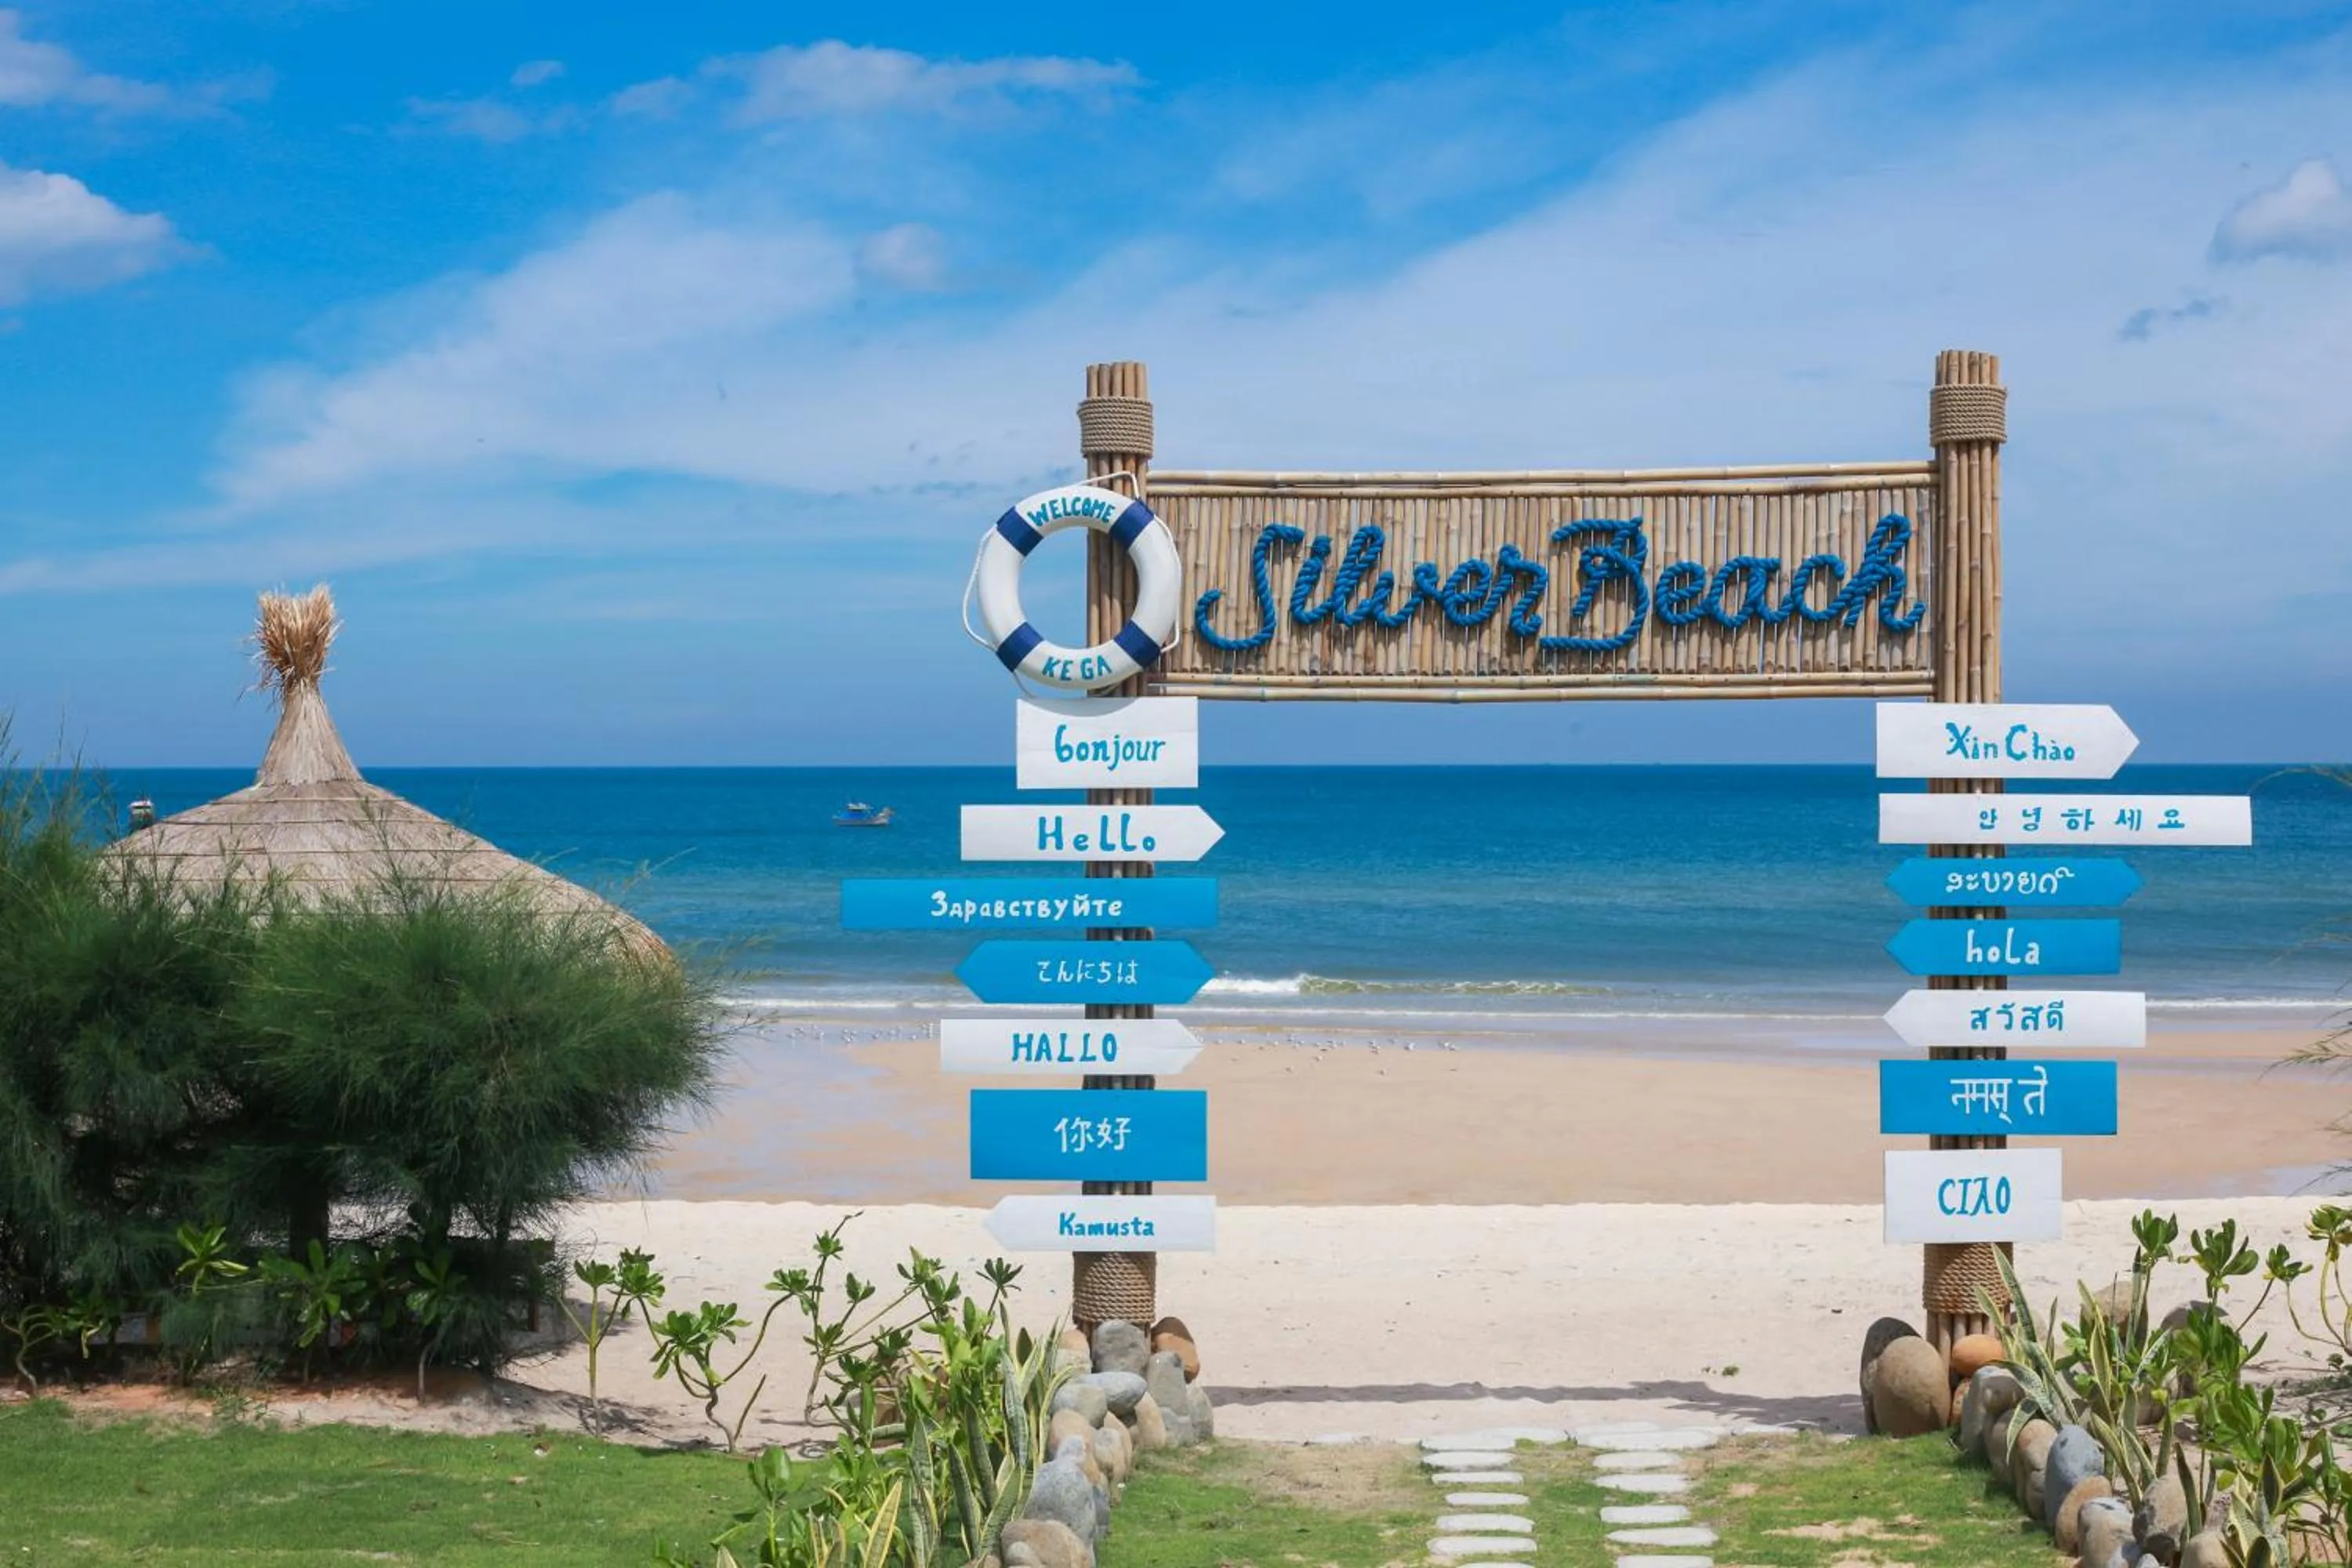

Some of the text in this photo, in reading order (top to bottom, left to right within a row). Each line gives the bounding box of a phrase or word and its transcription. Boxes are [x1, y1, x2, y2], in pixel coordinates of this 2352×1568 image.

[1027, 496, 1116, 528] WELCOME
[1195, 514, 1926, 652] Silver Beach
[1945, 722, 2075, 761] Xin Chào
[931, 891, 1123, 923] Здравствуйте
[1037, 960, 1139, 984] こんにちは
[1970, 1000, 2065, 1031] สวัสดี
[1012, 1033, 1118, 1062] HALLO
[1054, 1116, 1132, 1153] 你好
[1059, 1212, 1155, 1236] Kamusta
